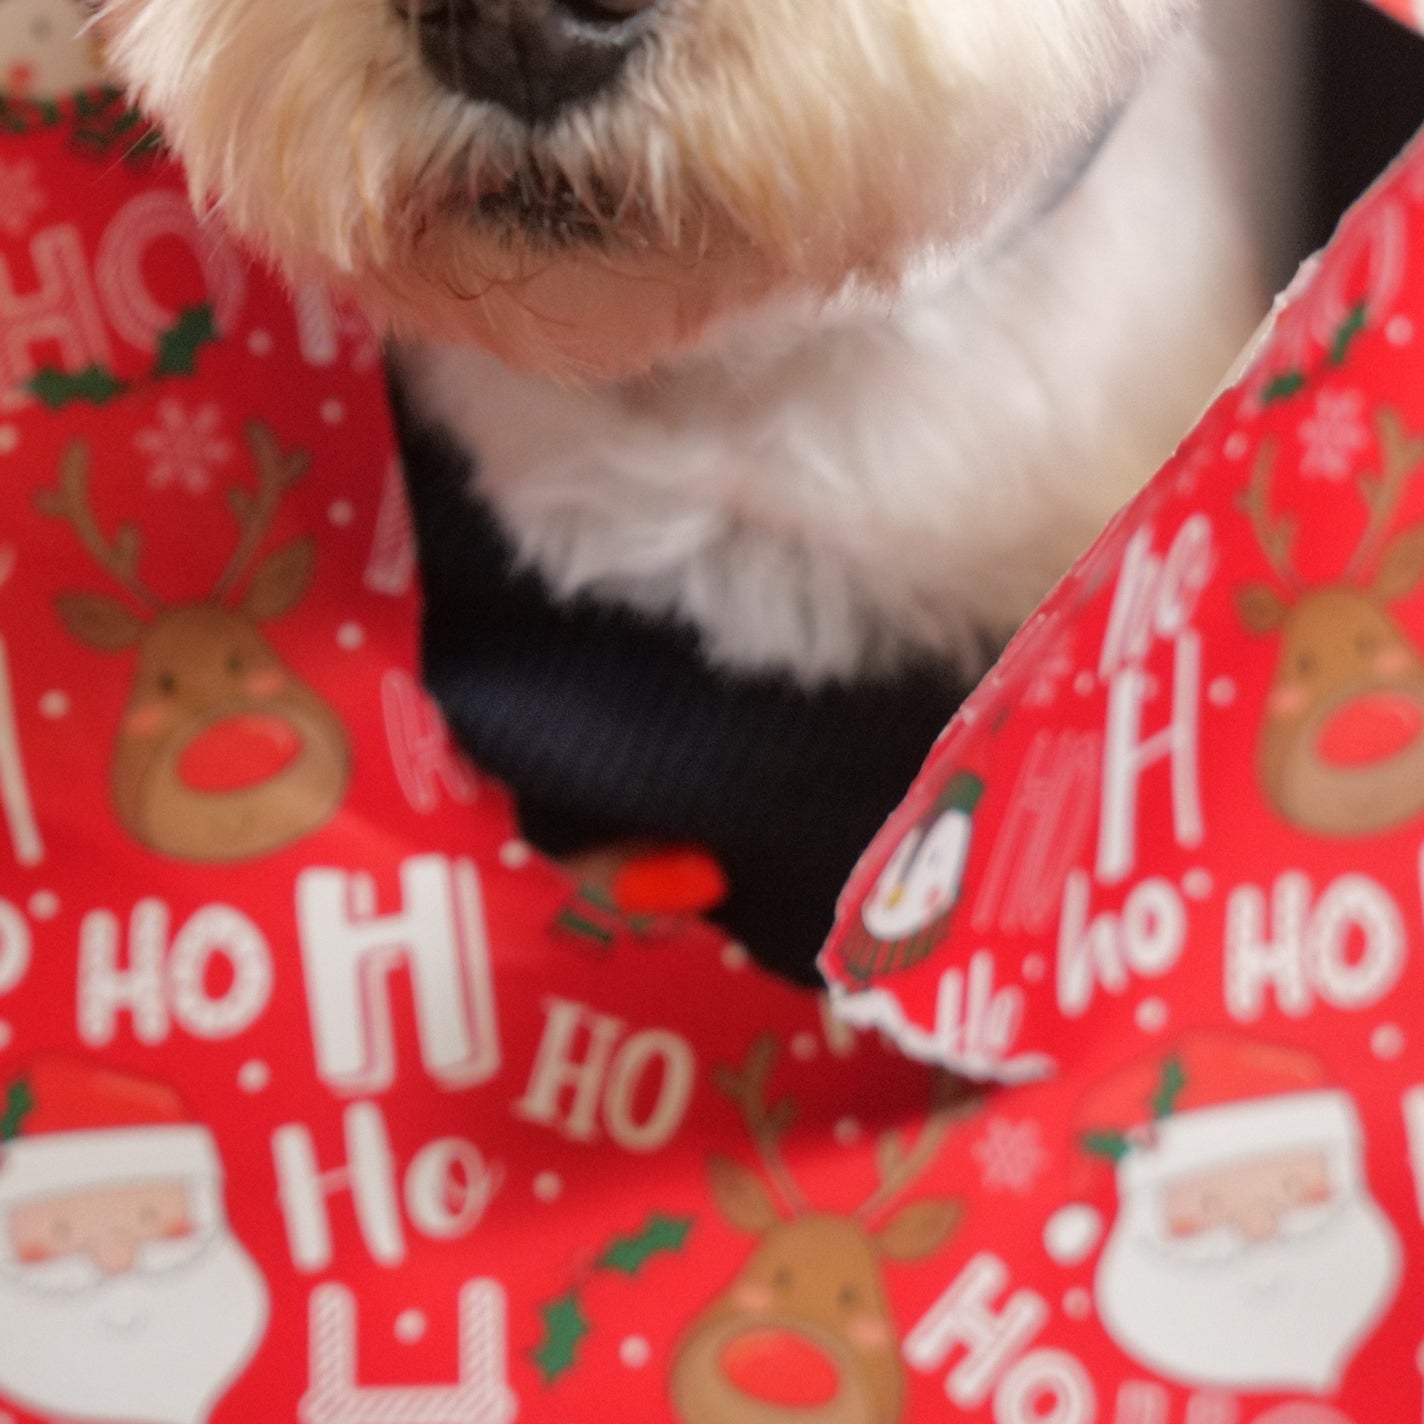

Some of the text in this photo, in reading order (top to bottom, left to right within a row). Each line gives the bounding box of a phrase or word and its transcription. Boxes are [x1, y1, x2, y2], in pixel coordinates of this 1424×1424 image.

[1096, 627, 1204, 886] H
[76, 897, 274, 1048] HO
[295, 851, 502, 1098] H
[1057, 867, 1187, 1017] ho
[1223, 869, 1407, 1022] HO
[514, 996, 695, 1154] HO
[271, 1100, 506, 1274] Ho
[902, 1251, 1097, 1424] HO
